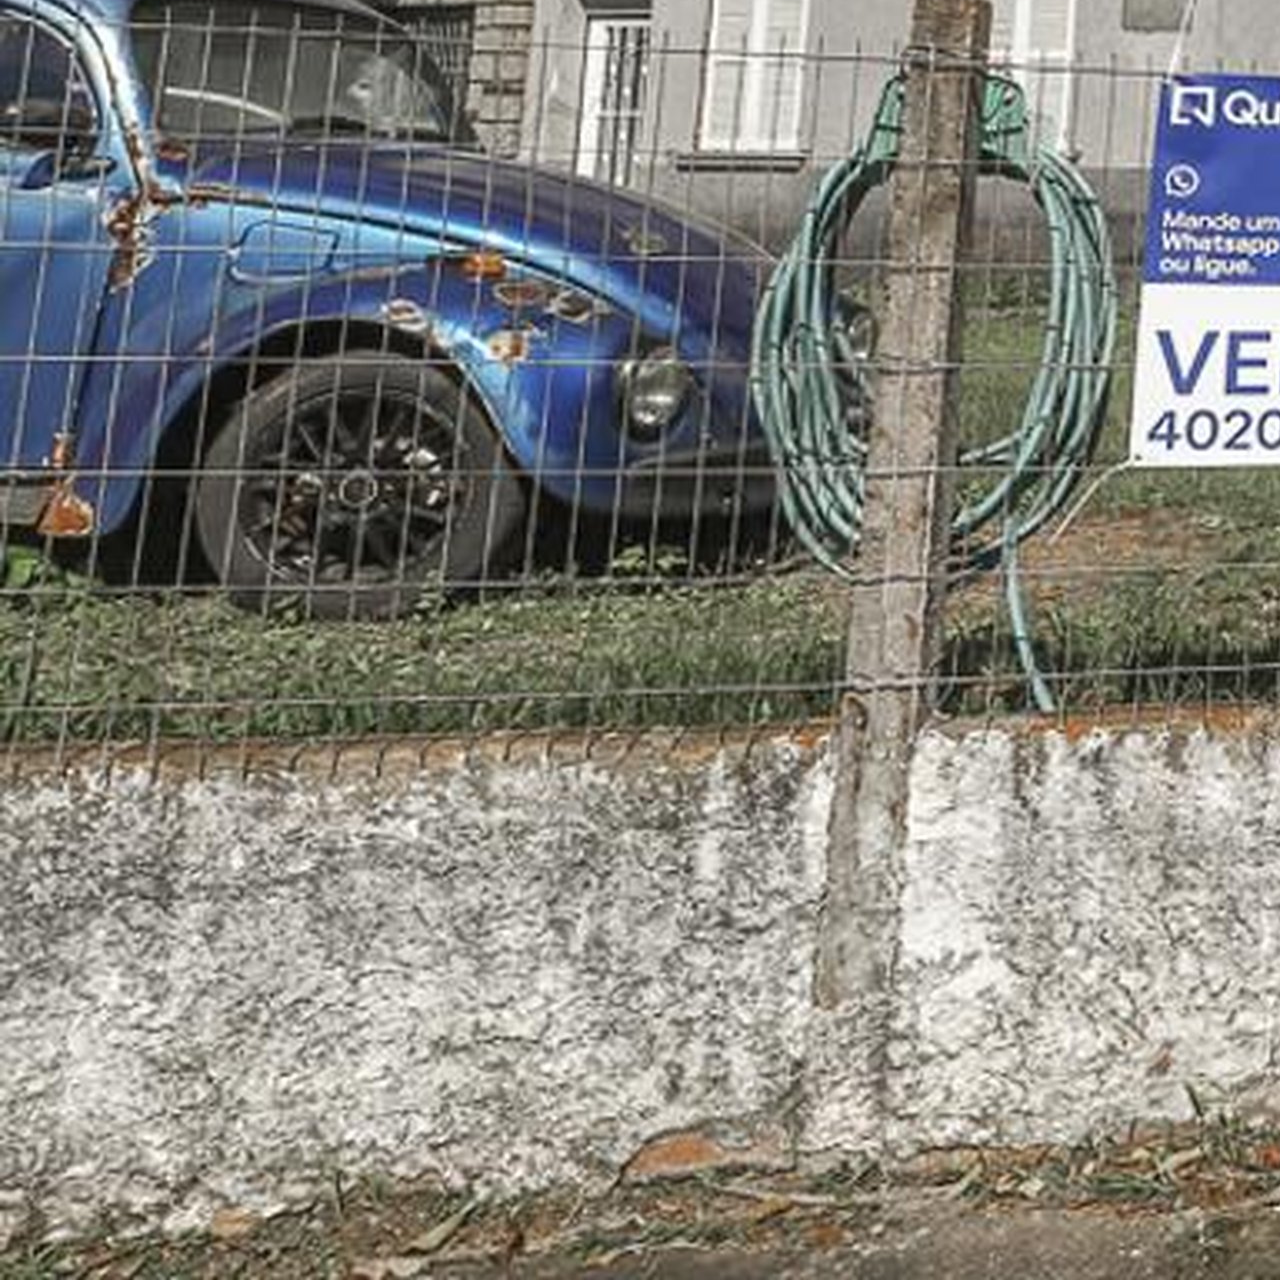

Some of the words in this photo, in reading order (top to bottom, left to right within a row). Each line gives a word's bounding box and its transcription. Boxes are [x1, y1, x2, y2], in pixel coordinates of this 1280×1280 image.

[1162, 209, 1241, 231] Mande
[1246, 215, 1280, 231] um
[1161, 231, 1280, 257] Whatsapp
[1160, 258, 1190, 273] ou
